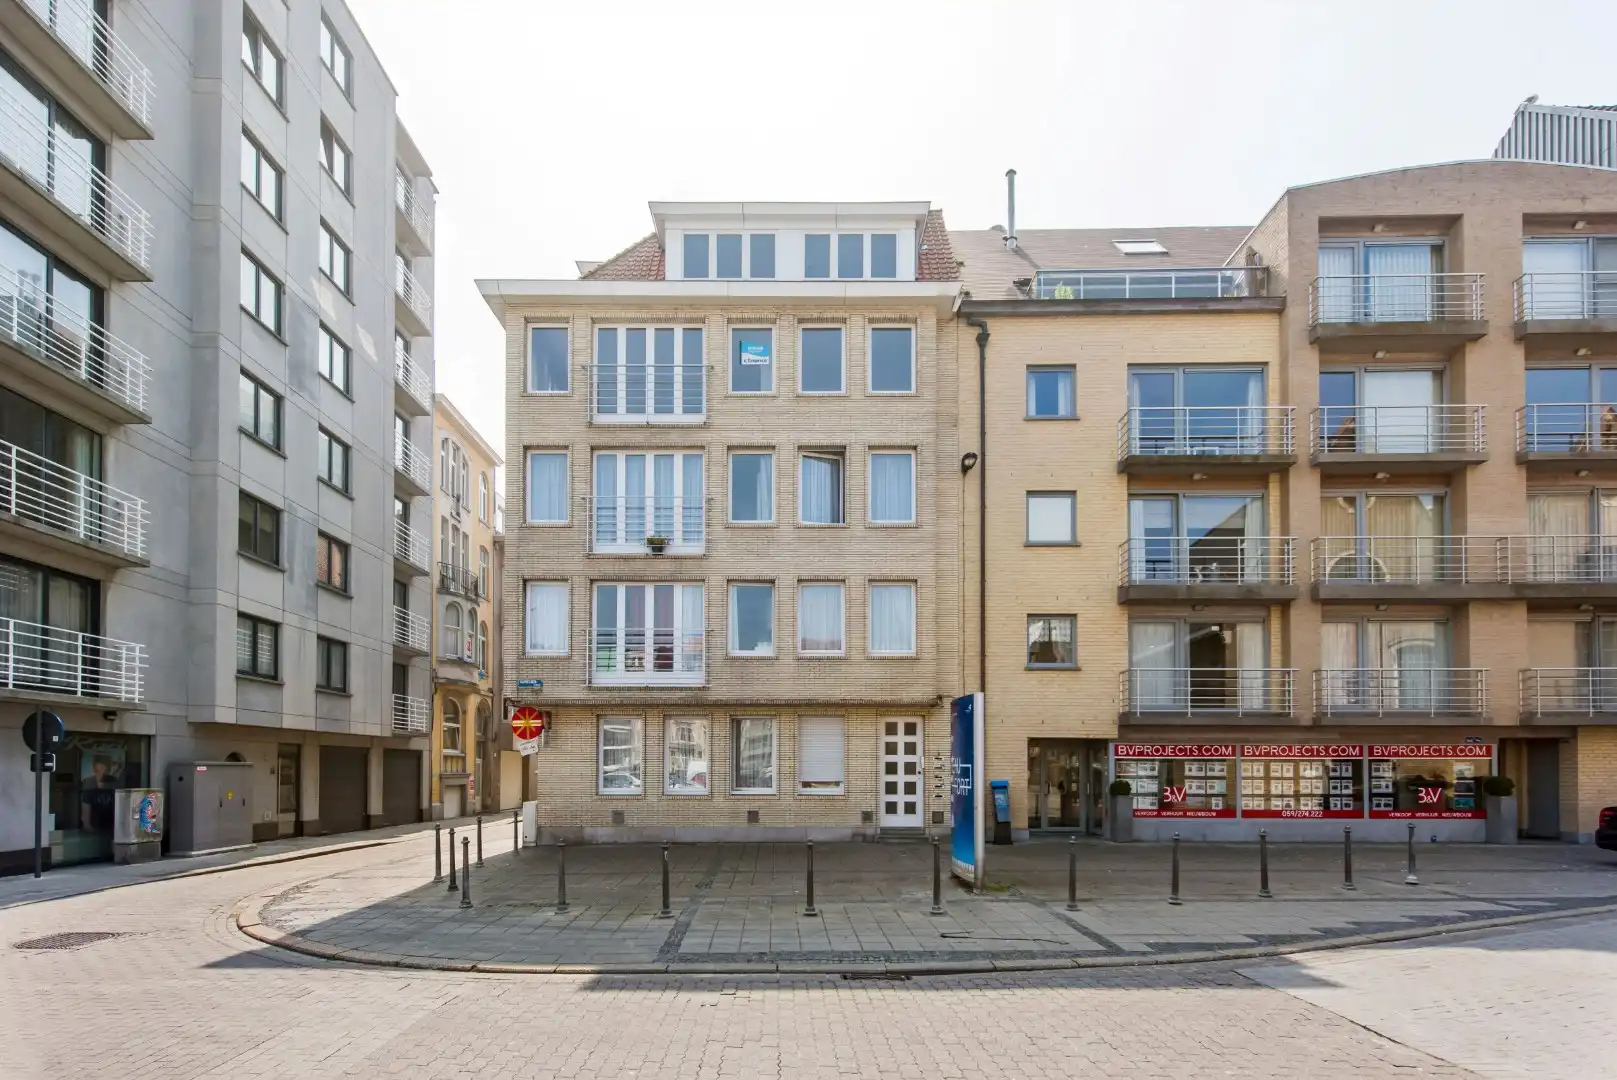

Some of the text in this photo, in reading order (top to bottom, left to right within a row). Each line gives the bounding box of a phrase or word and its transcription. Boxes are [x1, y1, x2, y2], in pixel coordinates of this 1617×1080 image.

[1118, 745, 1232, 756] BVPROJECTS.COM
[1244, 745, 1360, 756] BVPROJECTS.COM
[1373, 745, 1486, 756] BVPROJECTS.COM
